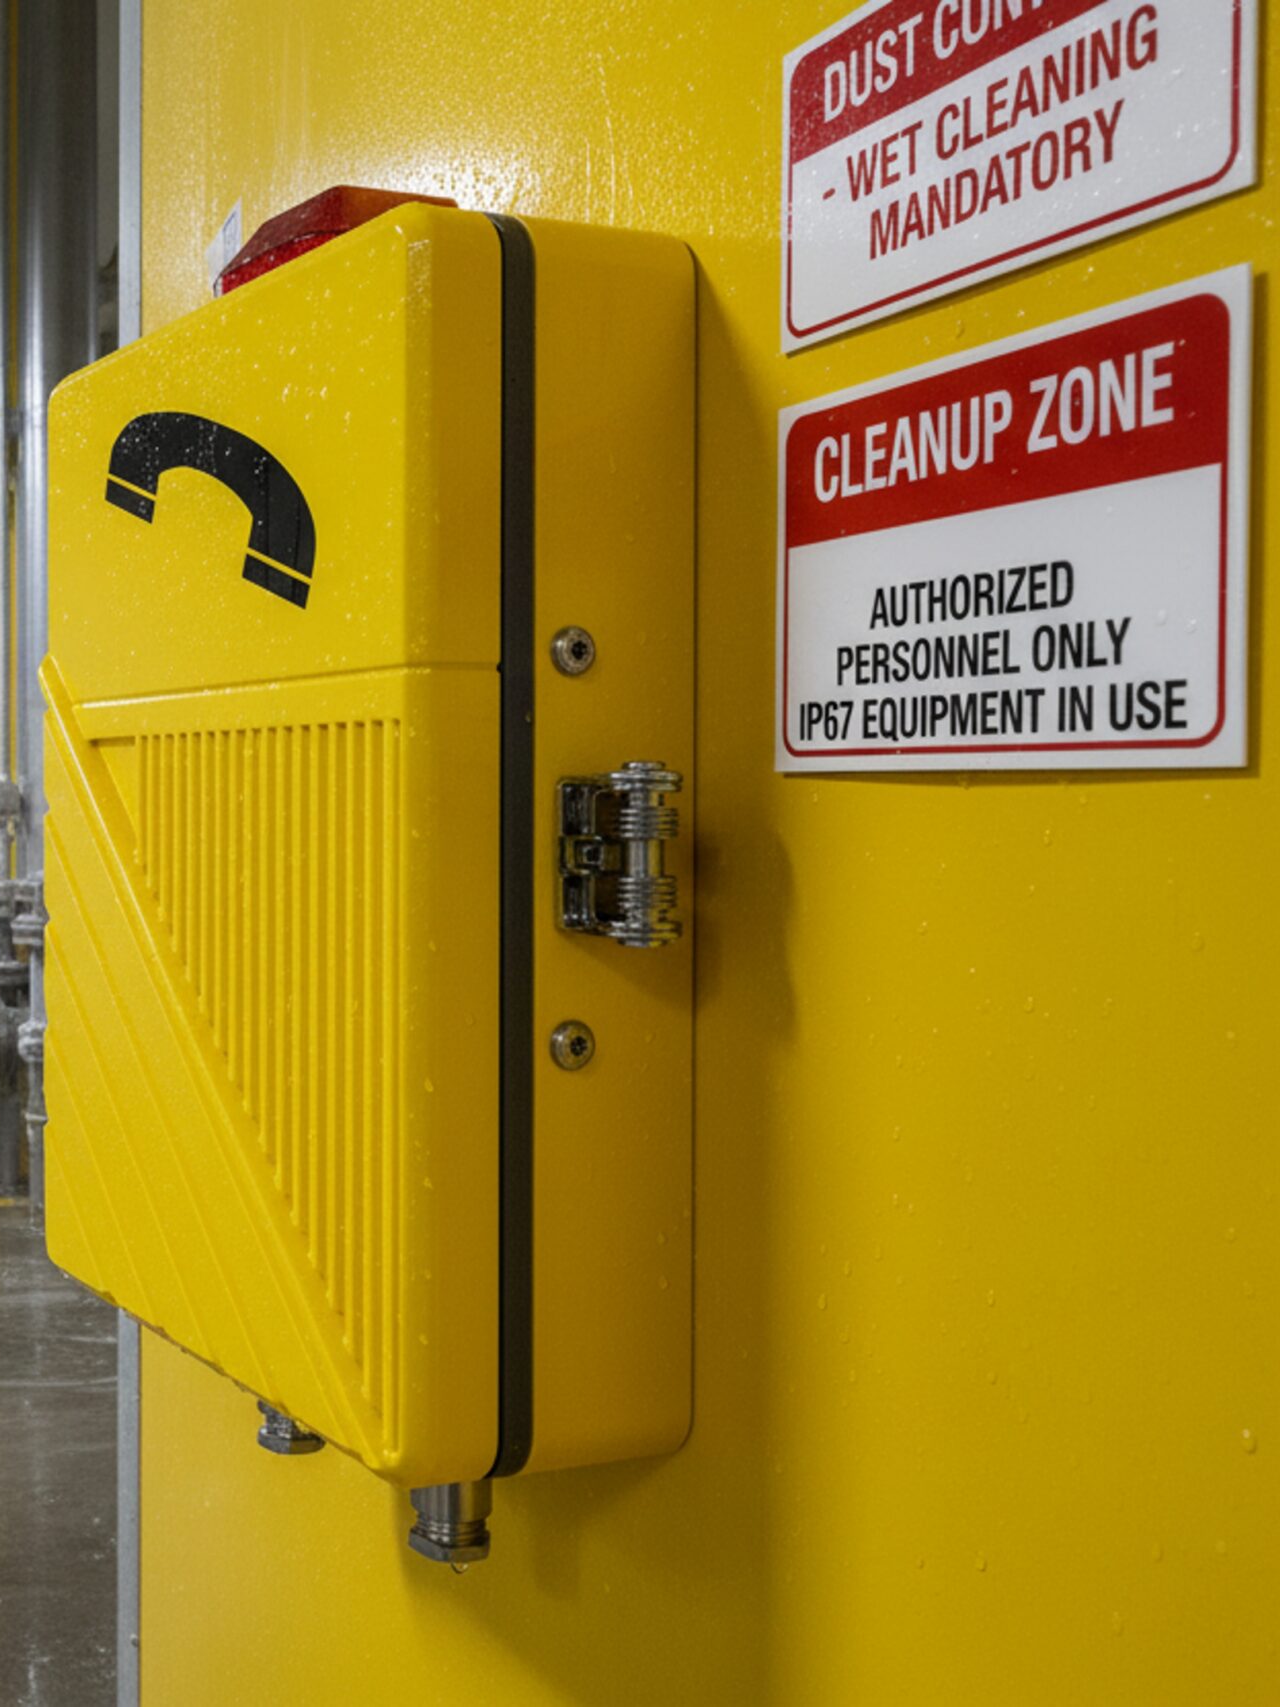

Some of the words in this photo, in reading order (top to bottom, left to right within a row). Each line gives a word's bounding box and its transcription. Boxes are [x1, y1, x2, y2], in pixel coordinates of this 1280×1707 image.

[823, 12, 923, 122] DUST
[847, 120, 923, 201] WET
[936, 4, 1158, 160] CLEANING
[869, 98, 1124, 260] MANDATORY
[814, 389, 1012, 503] CLEANUP
[1027, 341, 1175, 454] ZONE
[870, 560, 1074, 629] AUTHORIZED
[836, 630, 1020, 686] PERSONNEL
[1032, 617, 1131, 671] ONLY
[799, 701, 854, 741] IP67
[862, 688, 1045, 741] EQUIPMENT
[1058, 685, 1093, 731] IN
[1108, 680, 1188, 731] USE
